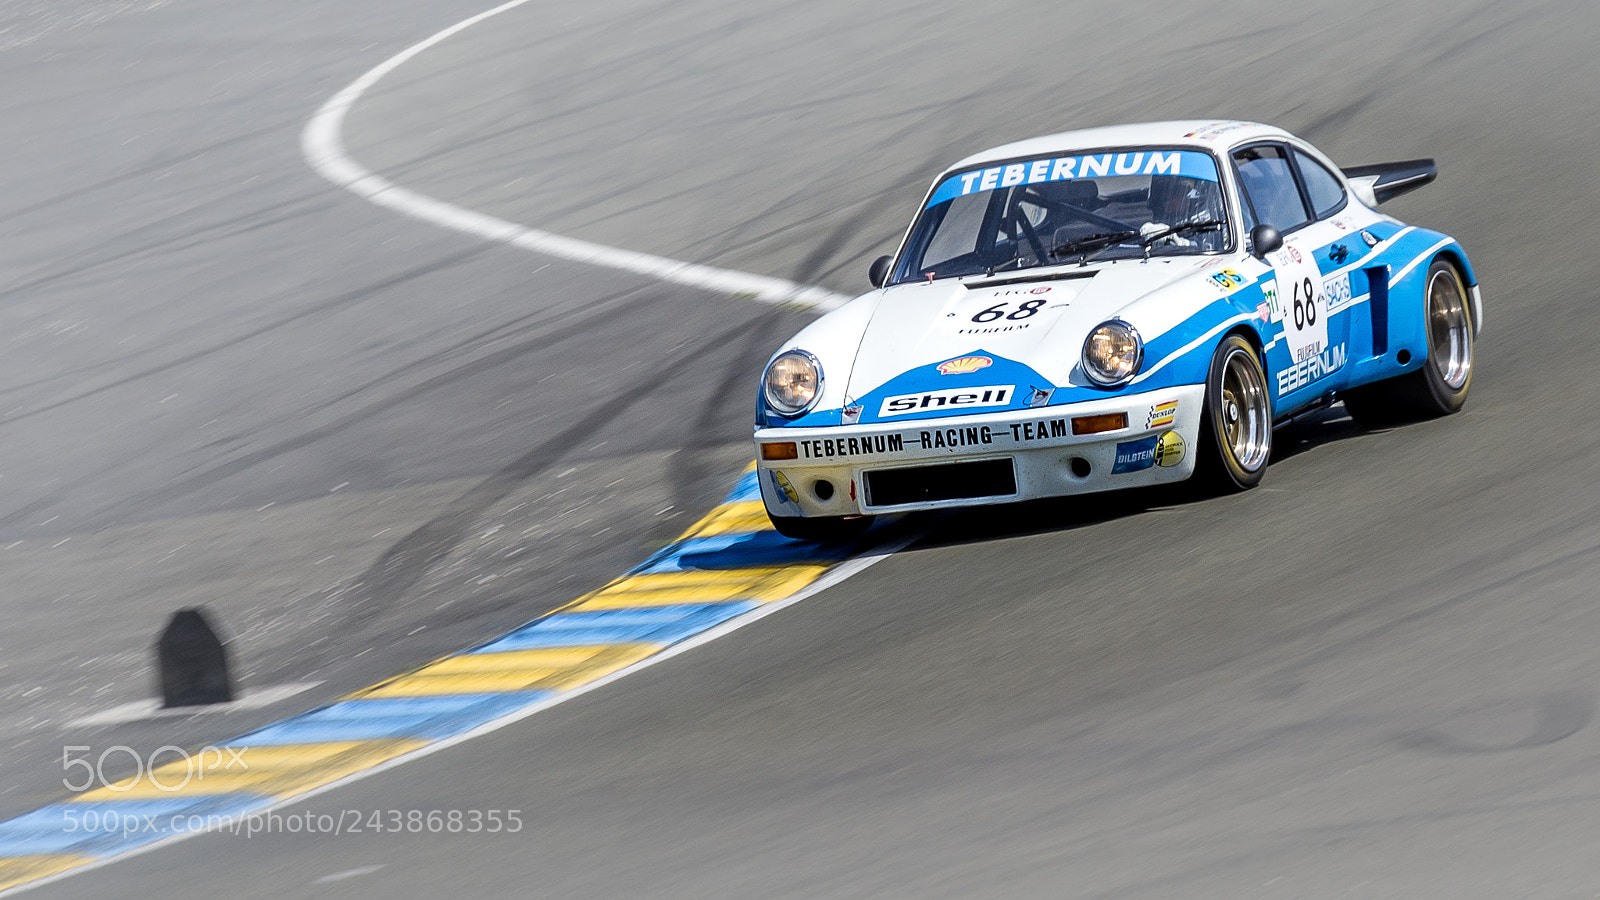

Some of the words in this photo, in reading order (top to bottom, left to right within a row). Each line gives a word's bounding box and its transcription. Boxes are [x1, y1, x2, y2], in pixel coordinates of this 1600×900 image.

[961, 152, 1181, 196] TEBERNUM
[1293, 276, 1316, 331] 68
[1326, 277, 1350, 306] SACHS
[971, 299, 1047, 323] 68
[887, 389, 1007, 412] Shell
[1152, 408, 1176, 419] DUNLOP
[801, 433, 904, 459] TEBERNUM
[920, 425, 992, 449] RACING
[1009, 418, 1067, 442] TEAM
